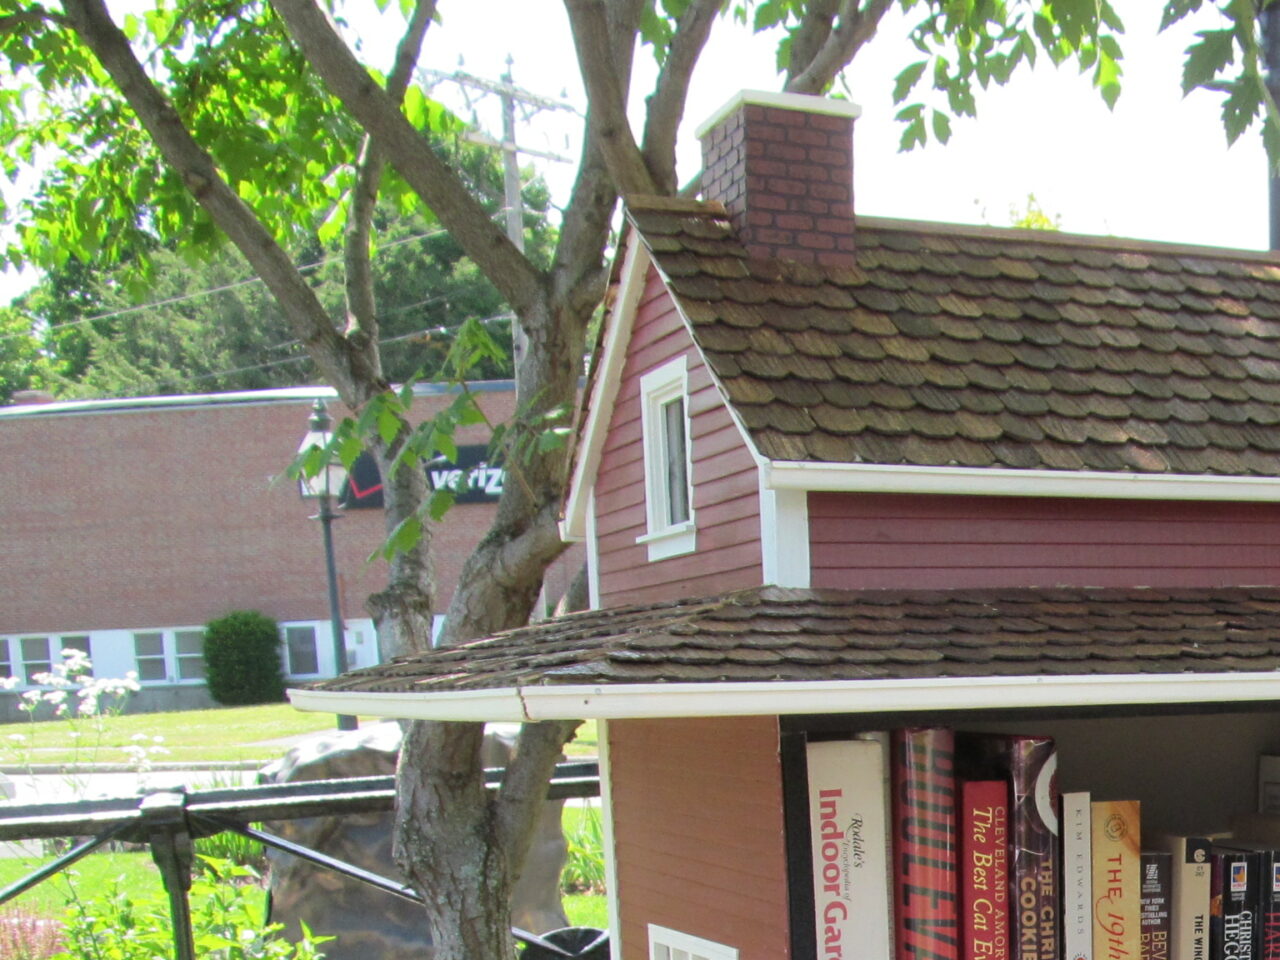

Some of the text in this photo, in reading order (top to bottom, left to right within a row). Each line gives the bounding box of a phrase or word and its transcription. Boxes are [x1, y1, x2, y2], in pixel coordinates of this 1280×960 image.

[430, 461, 505, 494] veriz
[819, 788, 844, 897] Indoor
[847, 813, 866, 868] Rodale's
[973, 807, 992, 843] The
[973, 851, 992, 890] Best
[995, 806, 1006, 902] CLEVELAND
[1040, 858, 1052, 896] THE
[1076, 854, 1084, 935] EDWARDS
[1107, 854, 1122, 898] THE
[973, 898, 992, 929] Cat
[1194, 914, 1204, 934] THE
[1108, 912, 1129, 960] 19th
